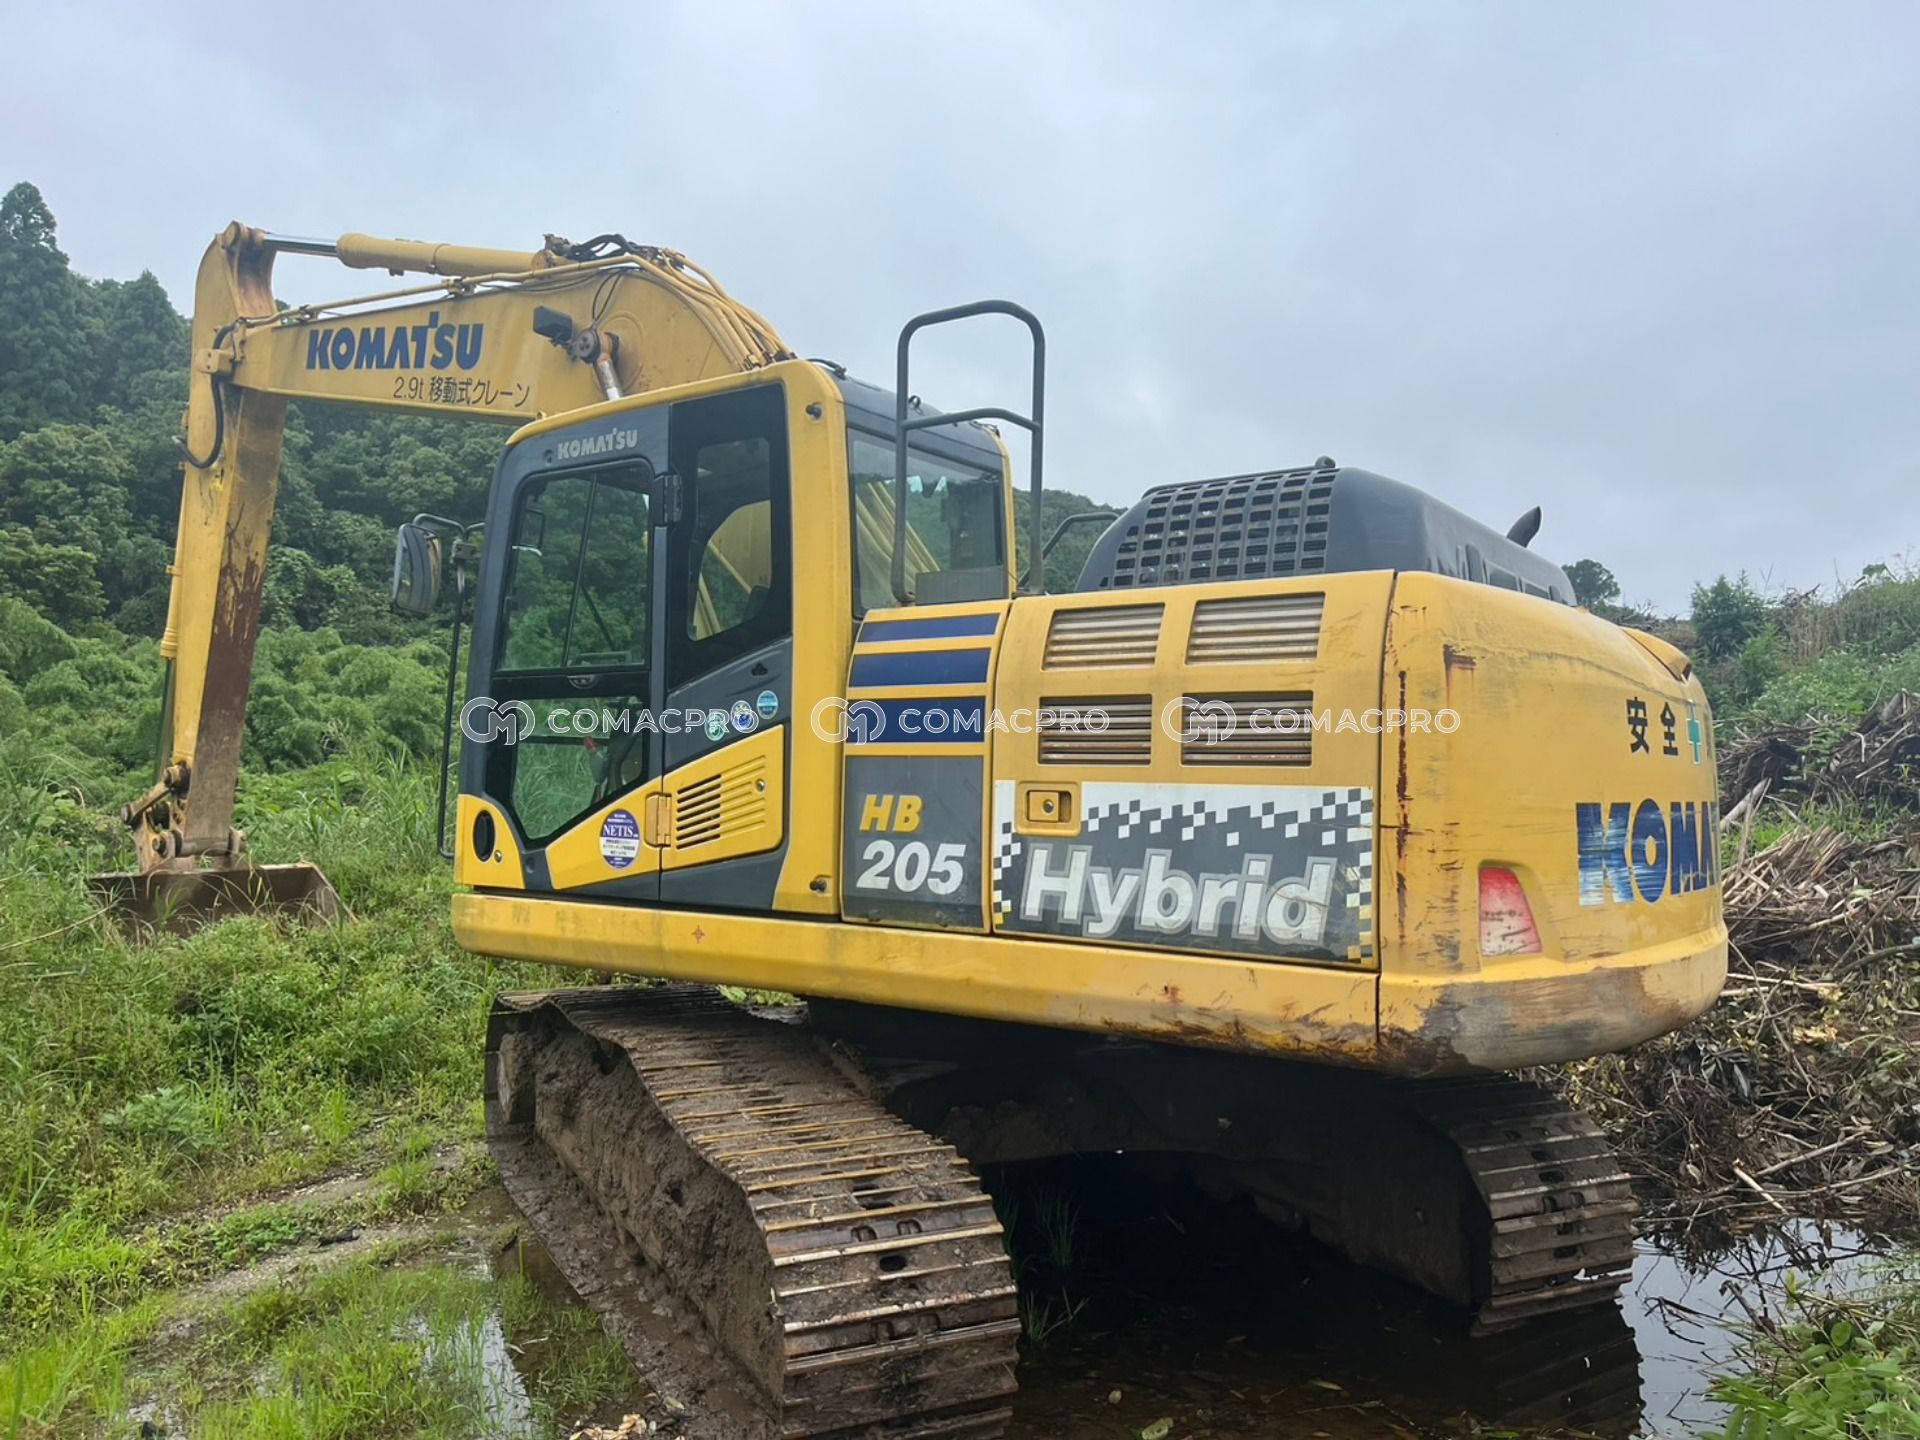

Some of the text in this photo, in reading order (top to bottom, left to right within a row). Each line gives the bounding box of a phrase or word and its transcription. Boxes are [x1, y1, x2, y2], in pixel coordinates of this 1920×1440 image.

[306, 311, 484, 371] KOMATSU
[393, 375, 530, 408] 2.9t 移動式クレーン
[557, 427, 638, 460] KOMATSU
[1626, 697, 1679, 756] 安全
[603, 823, 634, 838] NETIS
[859, 793, 924, 832] HB
[856, 839, 967, 895] 205
[1575, 798, 1718, 906] KOMA
[1019, 842, 1338, 947] Hybrid
